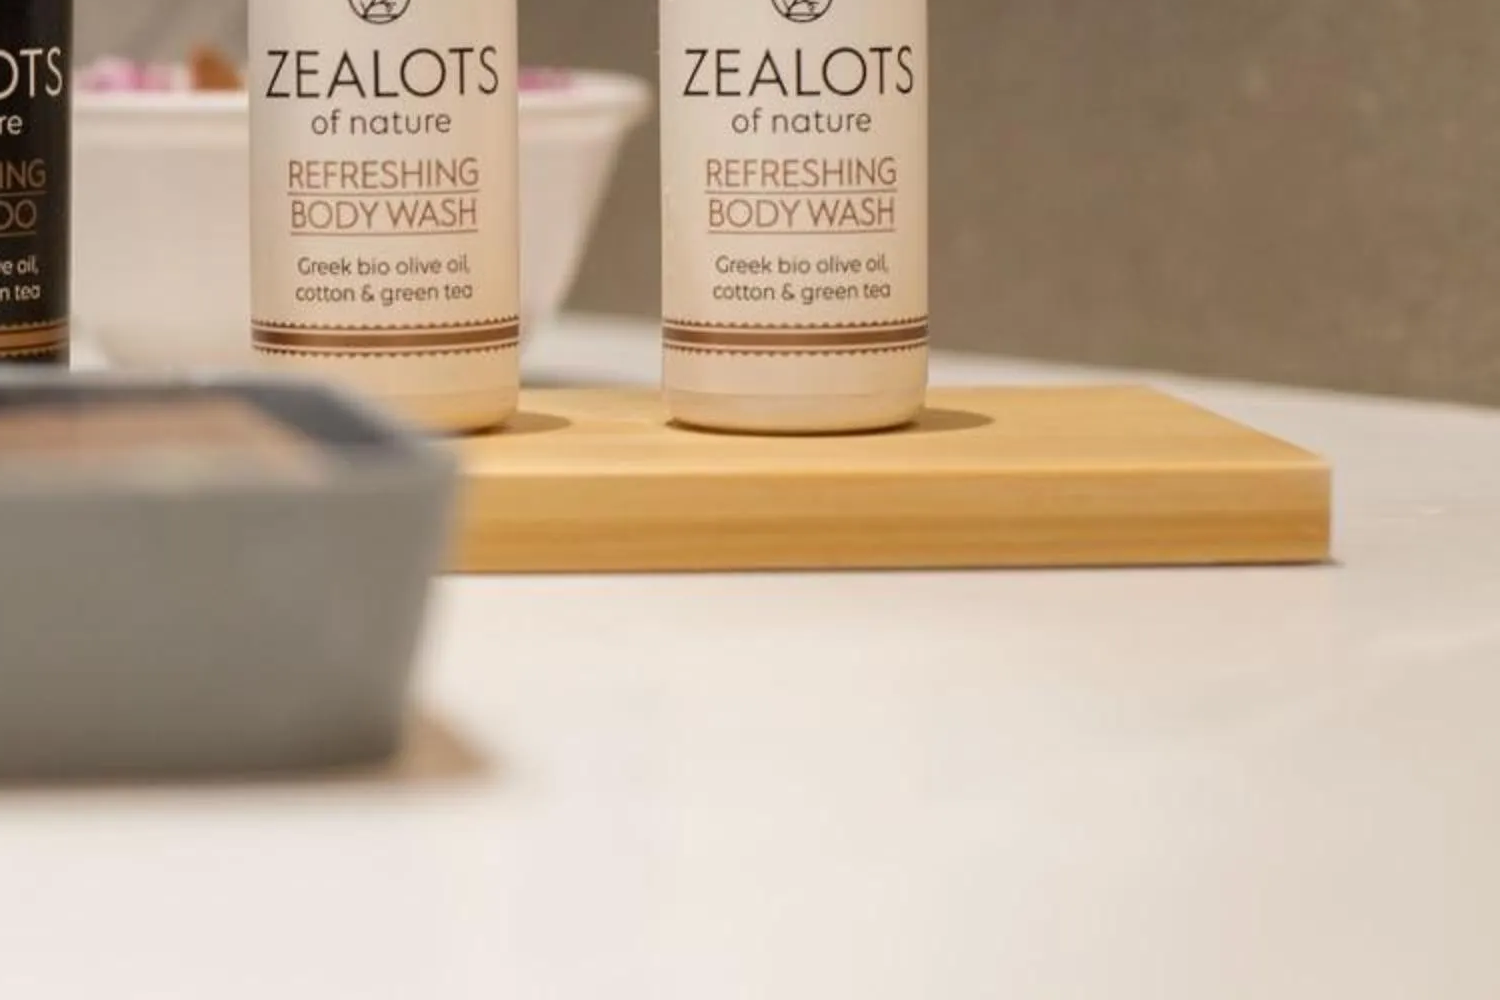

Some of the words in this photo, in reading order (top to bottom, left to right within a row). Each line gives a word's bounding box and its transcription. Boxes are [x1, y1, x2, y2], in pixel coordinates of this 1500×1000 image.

[265, 45, 499, 99] ZEALOTS
[683, 45, 914, 97] ZEALOTS
[311, 108, 340, 136] of
[350, 109, 452, 136] nature
[732, 108, 762, 135] of
[772, 108, 871, 134] nature
[288, 157, 479, 189] REFRESHING
[706, 156, 897, 187] REFRESHING
[291, 201, 377, 230] BODY
[388, 198, 477, 228] WASH
[709, 199, 800, 228] BODY
[805, 196, 895, 226] WASH
[298, 257, 352, 276] Greek
[357, 257, 390, 276] bio
[395, 256, 442, 275] olive
[716, 255, 772, 275] Greek
[778, 255, 811, 275] bio
[816, 254, 862, 274] olive
[15, 284, 40, 300] tea
[296, 285, 355, 302] cotton
[361, 285, 374, 302] &
[381, 285, 439, 307] green
[444, 283, 472, 300] tea
[713, 285, 775, 301] cotton
[782, 284, 795, 301] &
[801, 284, 858, 305] green
[863, 282, 890, 299] tea
